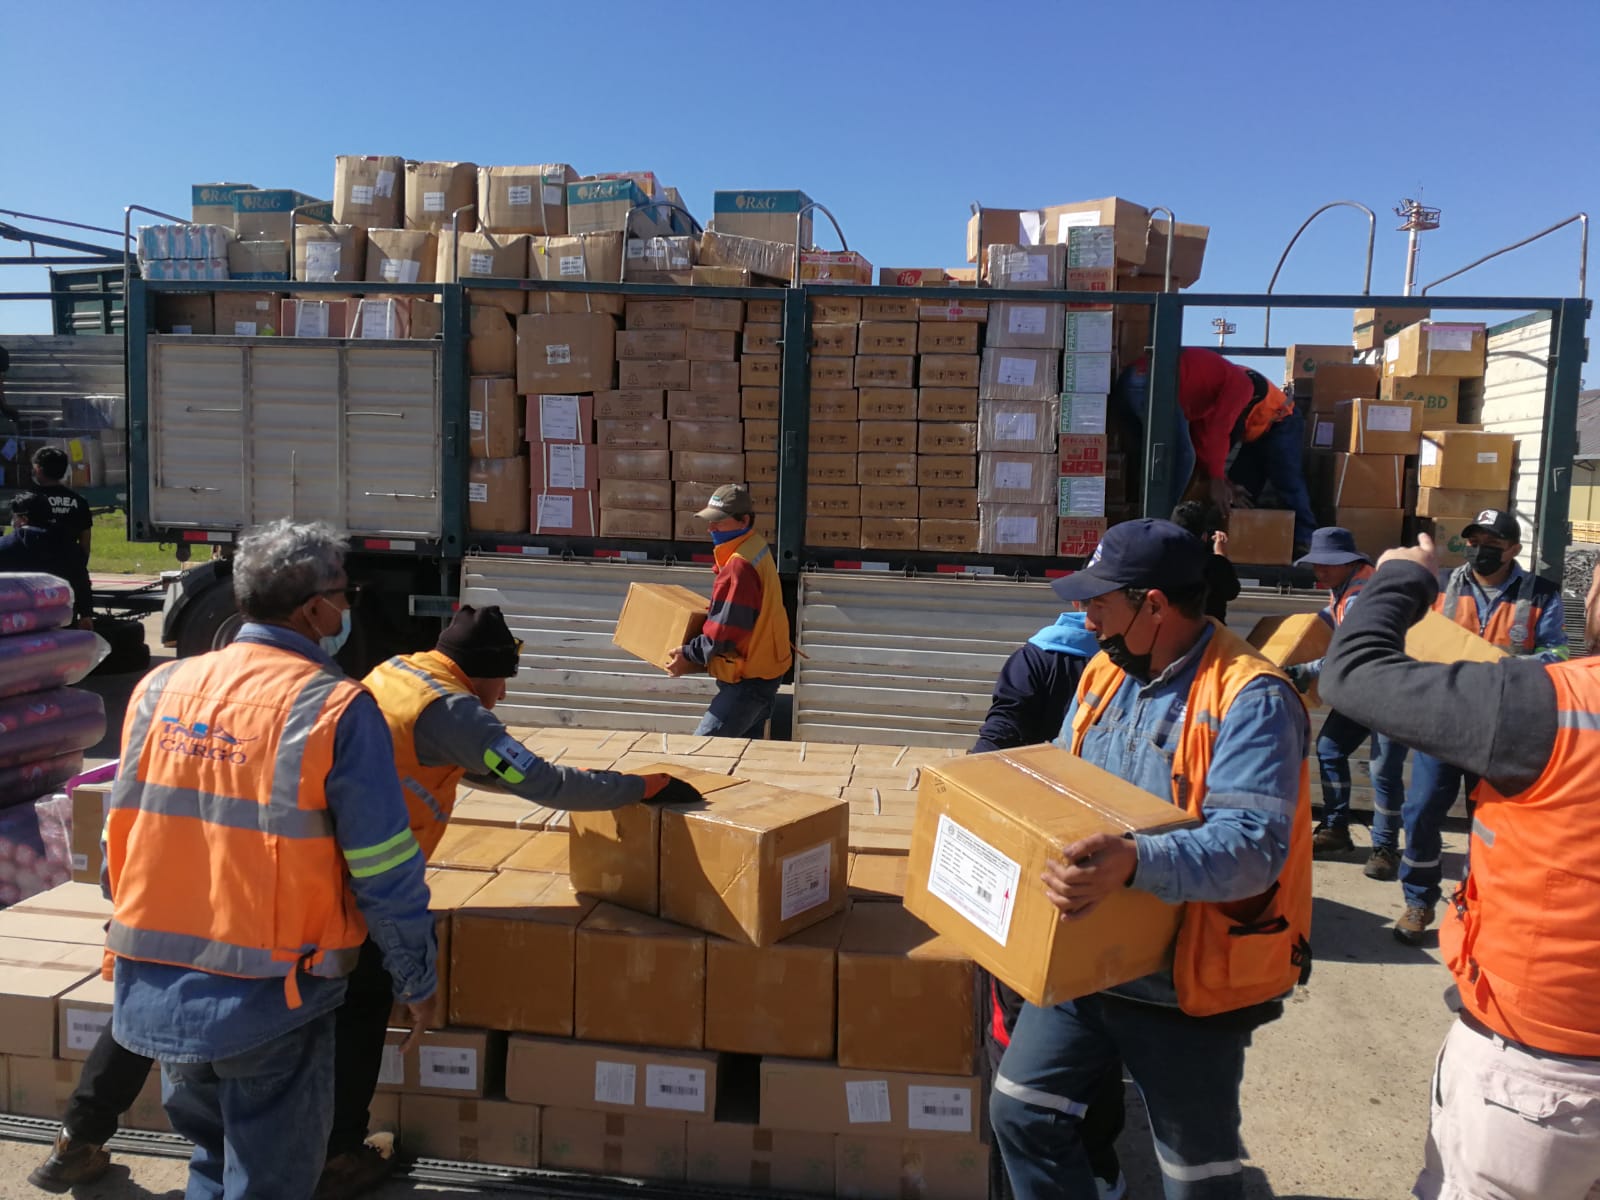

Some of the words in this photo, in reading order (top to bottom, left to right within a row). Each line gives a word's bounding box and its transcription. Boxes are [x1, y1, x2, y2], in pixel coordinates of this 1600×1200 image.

[252, 196, 281, 209] R&G
[745, 197, 777, 209] R&G
[1067, 313, 1077, 351] FRAGIL
[1065, 354, 1074, 393] FRAGIL
[1062, 394, 1071, 432] FRAGIL
[48, 496, 78, 509] OREA
[1060, 480, 1071, 514] FRAGIL
[160, 738, 247, 765] CARGO
